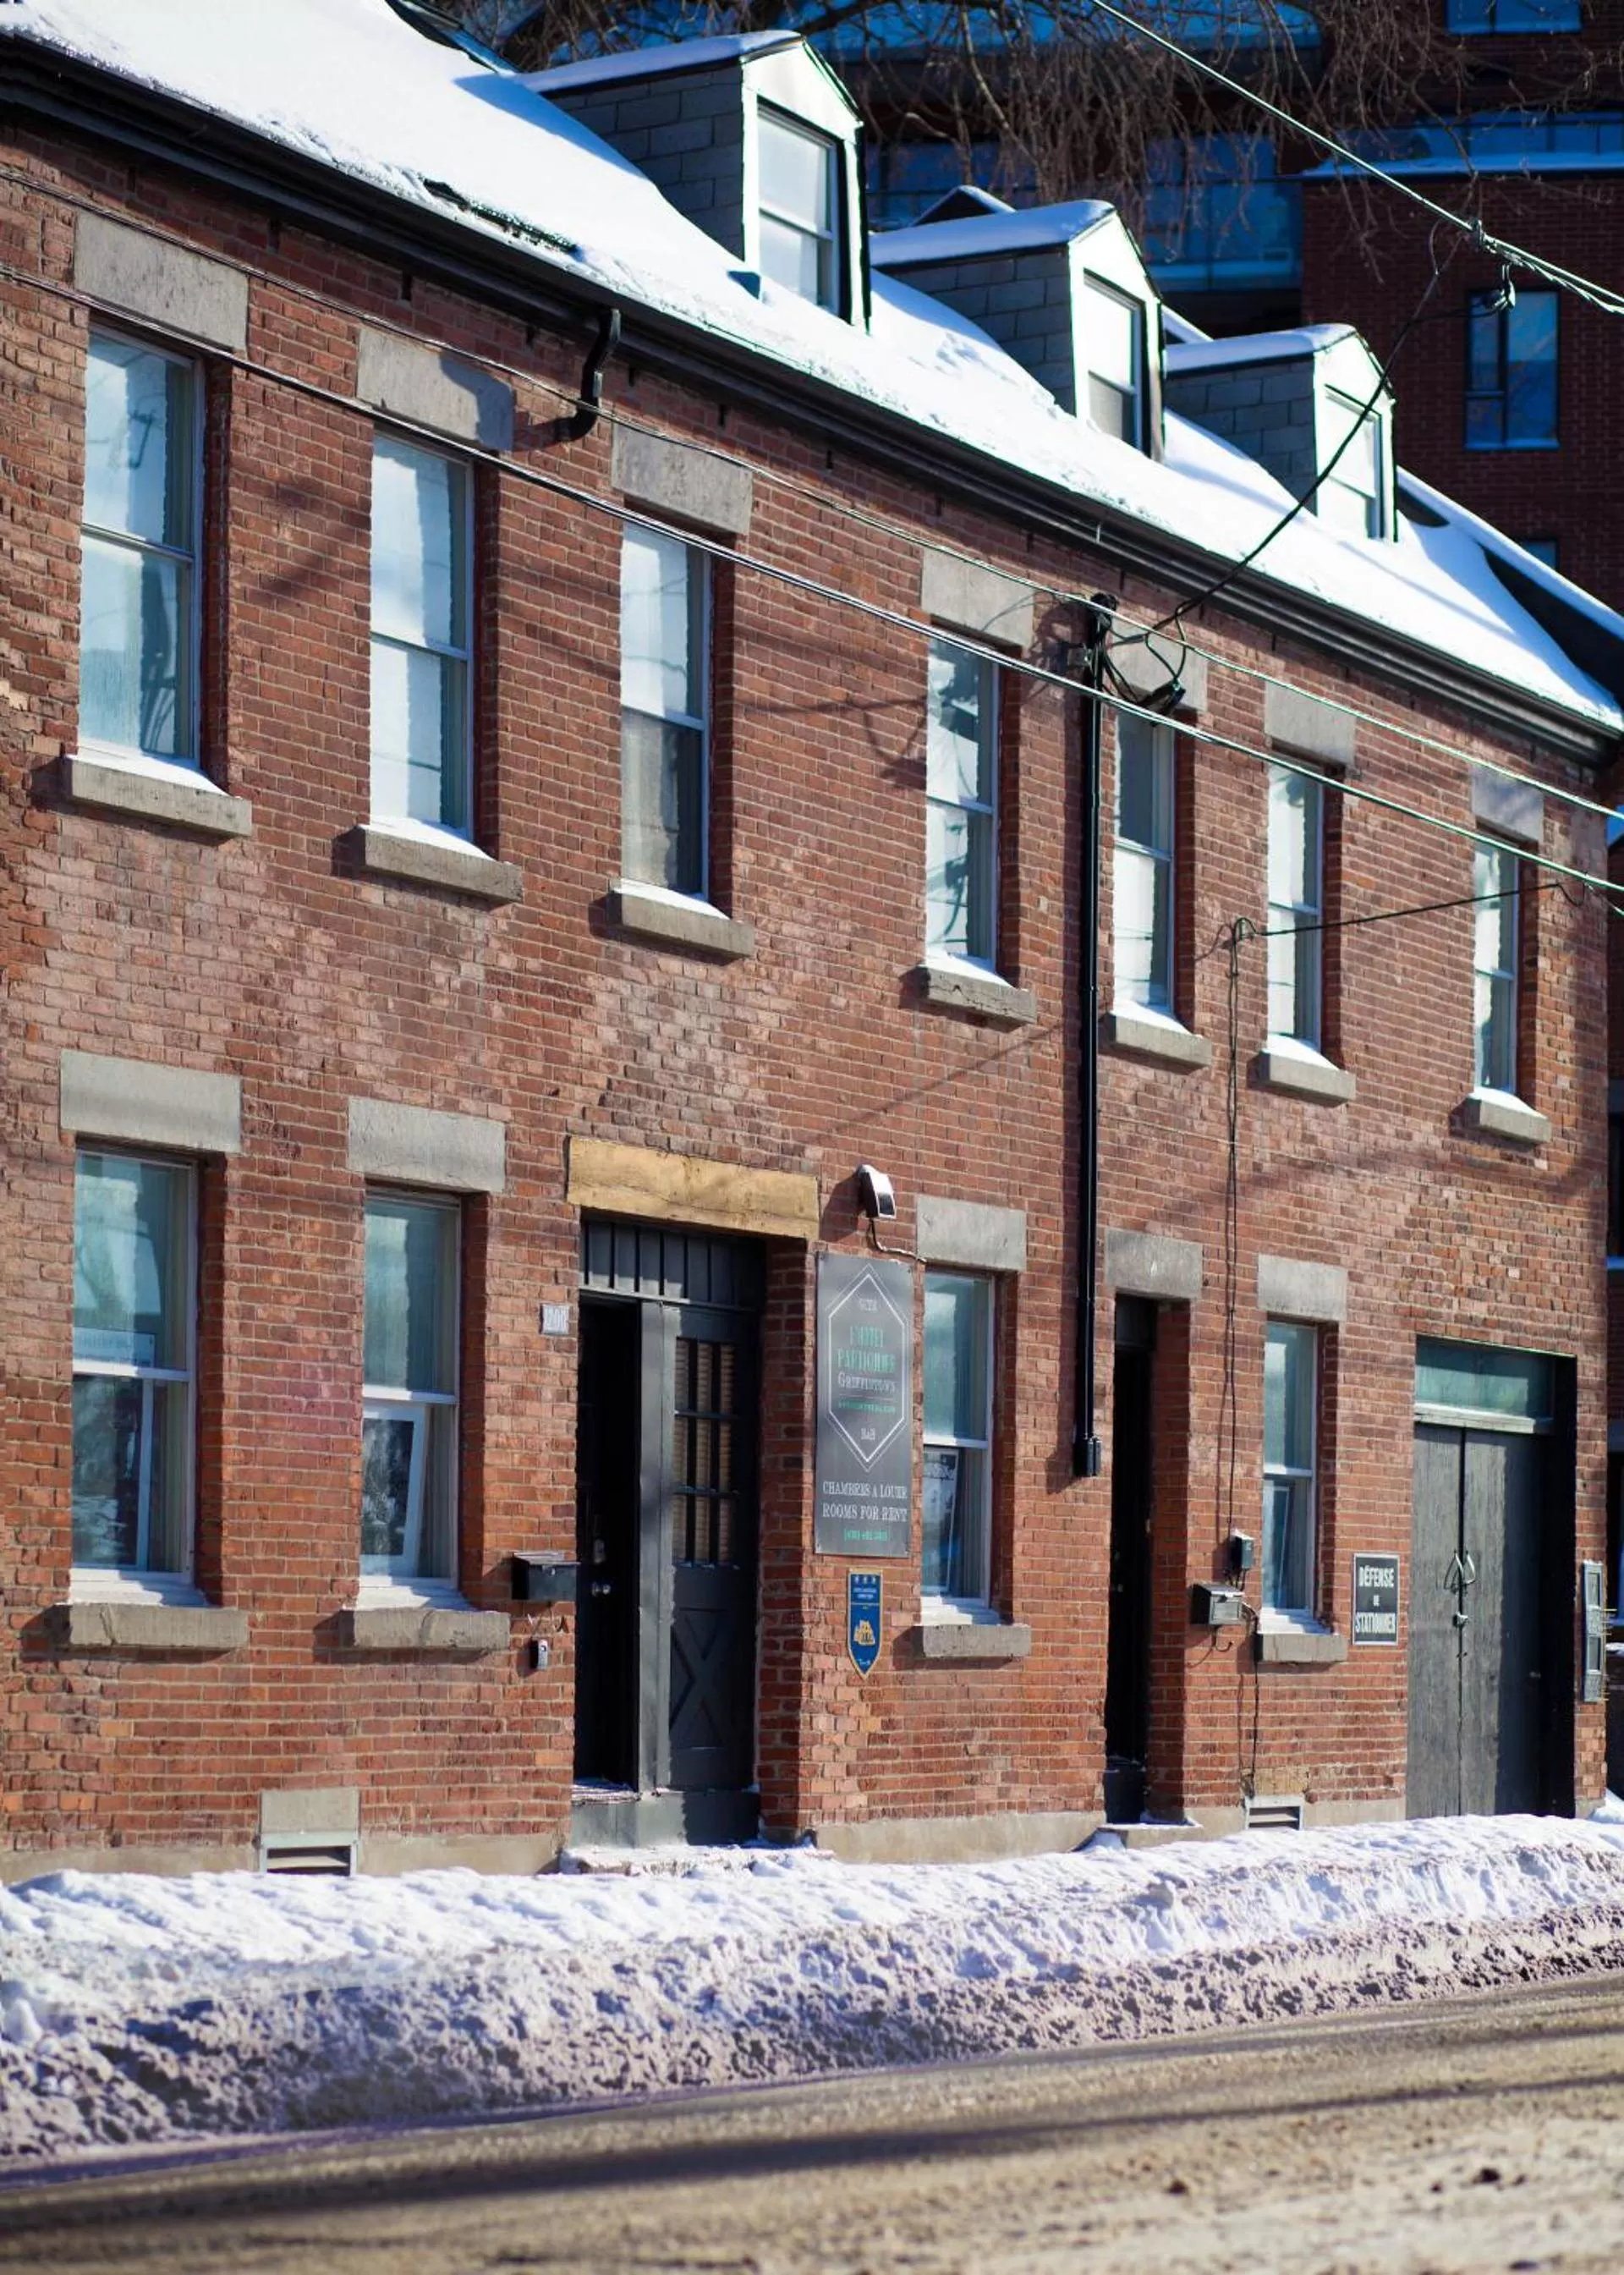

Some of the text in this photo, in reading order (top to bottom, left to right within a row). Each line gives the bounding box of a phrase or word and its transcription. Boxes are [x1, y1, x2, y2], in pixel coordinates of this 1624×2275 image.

[822, 1481, 870, 1497] CHAMBRES
[880, 1483, 908, 1499] LOUER
[822, 1503, 908, 1523] ROOMS FOR RENT
[1358, 1564, 1395, 1588] DÉFENSE
[1355, 1611, 1396, 1635] STATIONNER
